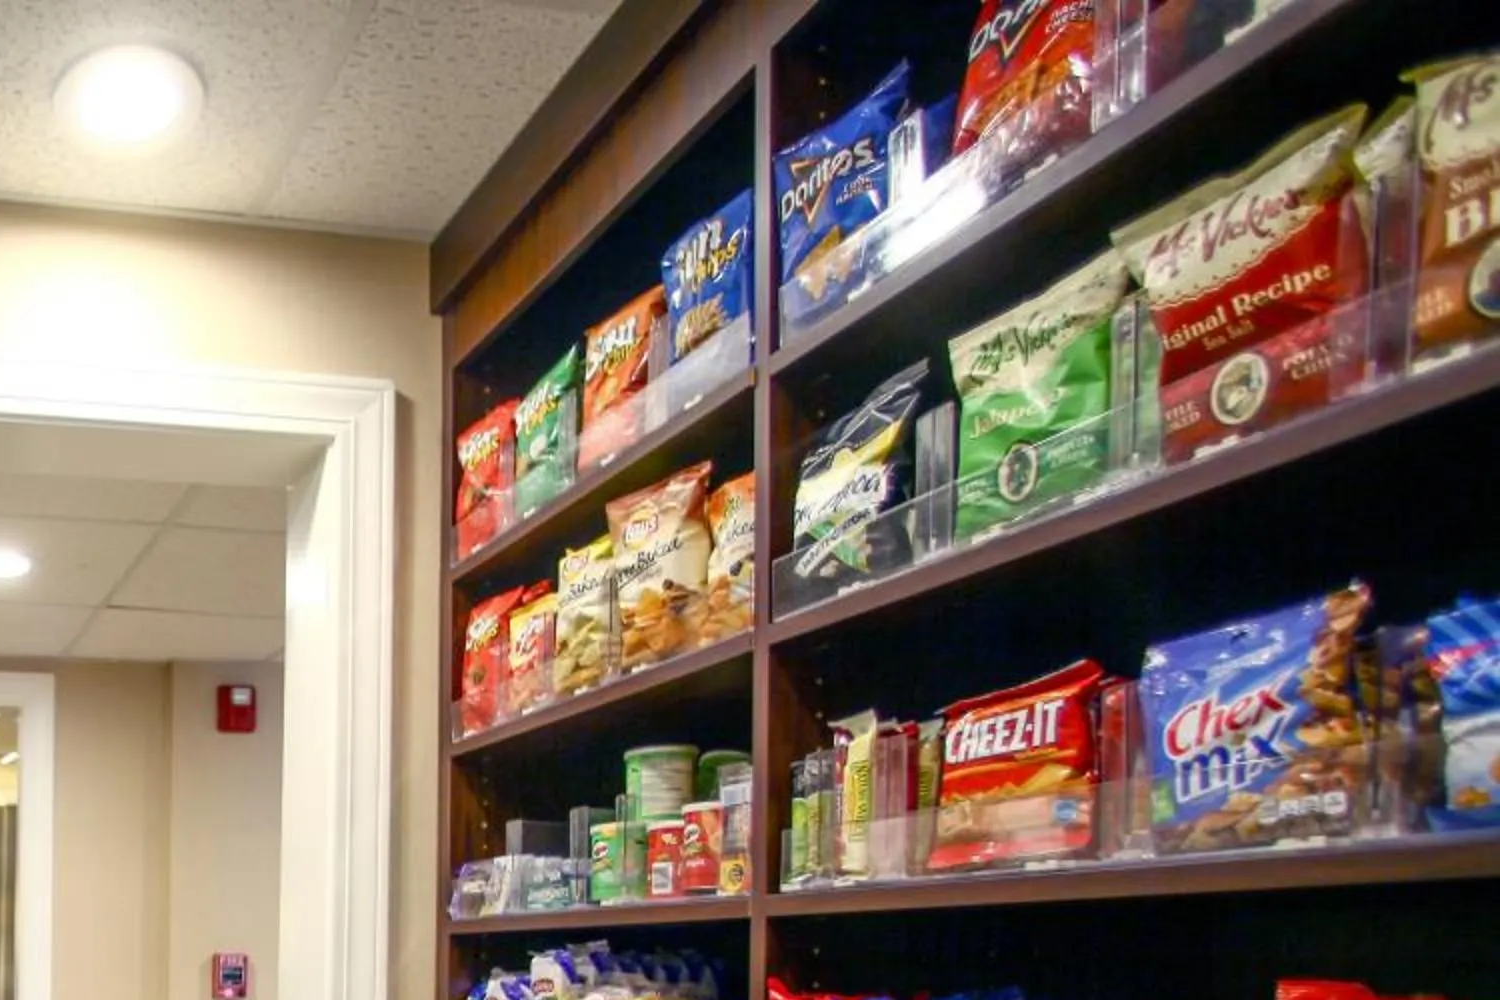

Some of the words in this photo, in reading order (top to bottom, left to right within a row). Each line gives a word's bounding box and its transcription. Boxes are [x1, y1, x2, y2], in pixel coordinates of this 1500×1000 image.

[781, 137, 874, 223] Doritos
[1163, 305, 1228, 351] iginal
[1231, 263, 1333, 317] Recipe
[1166, 688, 1288, 760] Chex
